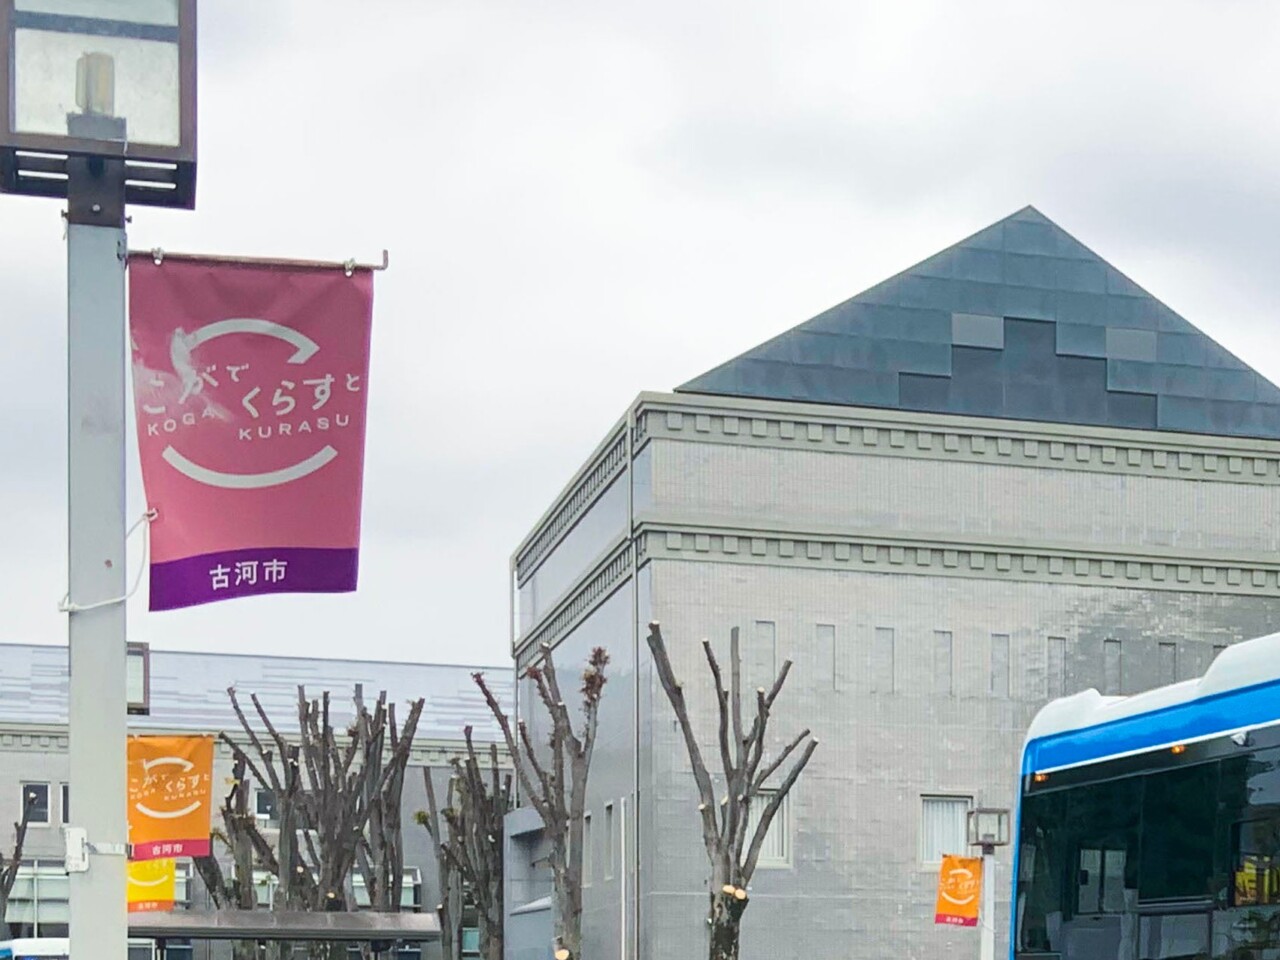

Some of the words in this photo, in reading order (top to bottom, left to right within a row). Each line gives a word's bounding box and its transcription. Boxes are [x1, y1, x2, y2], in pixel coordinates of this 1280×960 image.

[147, 403, 218, 436] KOGA
[239, 412, 350, 441] KURASU
[208, 558, 288, 591] 古河市
